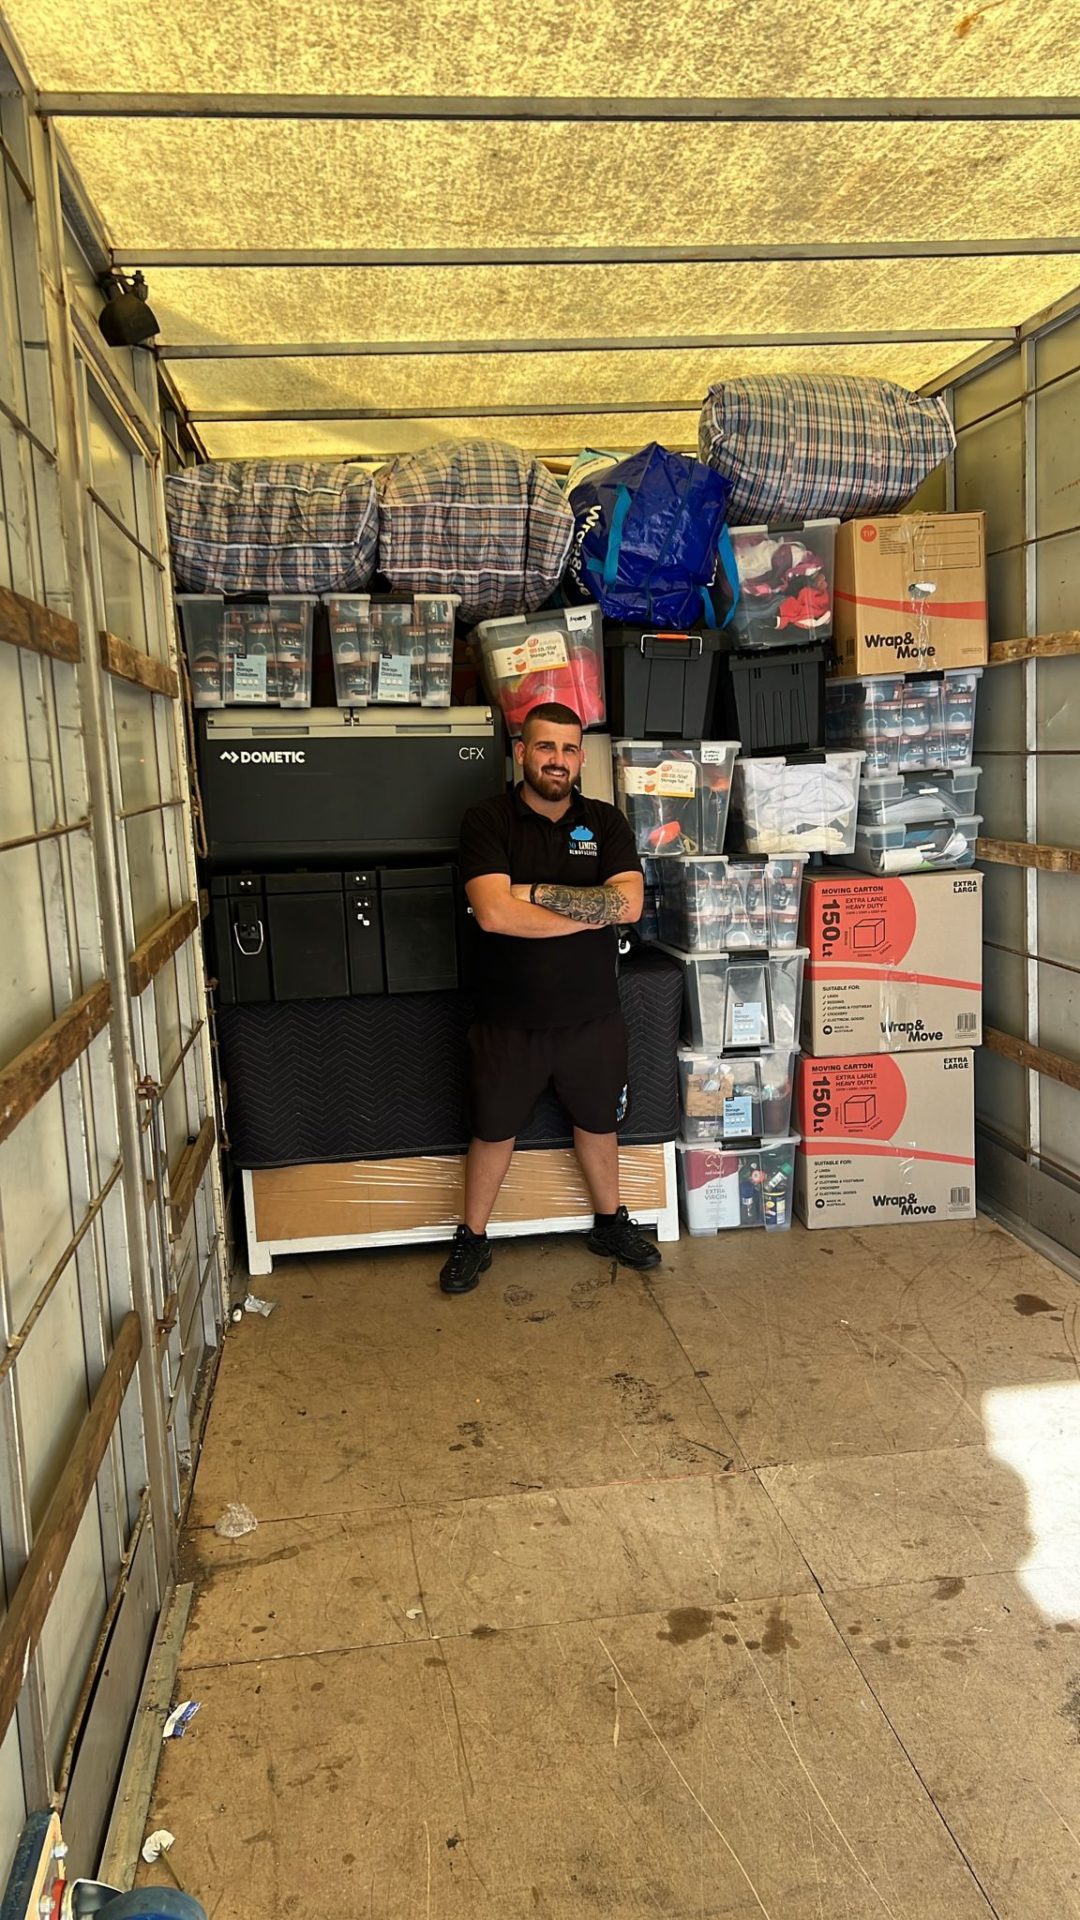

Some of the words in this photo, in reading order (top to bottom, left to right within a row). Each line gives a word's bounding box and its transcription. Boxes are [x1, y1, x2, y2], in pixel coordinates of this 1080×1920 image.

[865, 632, 914, 649] Wrap&
[897, 645, 936, 659] Move
[241, 751, 305, 764] DOMETIC
[459, 747, 485, 760] CFX
[578, 841, 598, 851] LIMITS
[822, 887, 851, 895] MOVING
[822, 899, 841, 957] 150Lt
[880, 1019, 924, 1034] Wrap&
[908, 1031, 943, 1042] Move
[812, 1076, 831, 1133] 150Lt
[873, 1193, 917, 1208] Wrap&
[901, 1204, 936, 1215] Move
